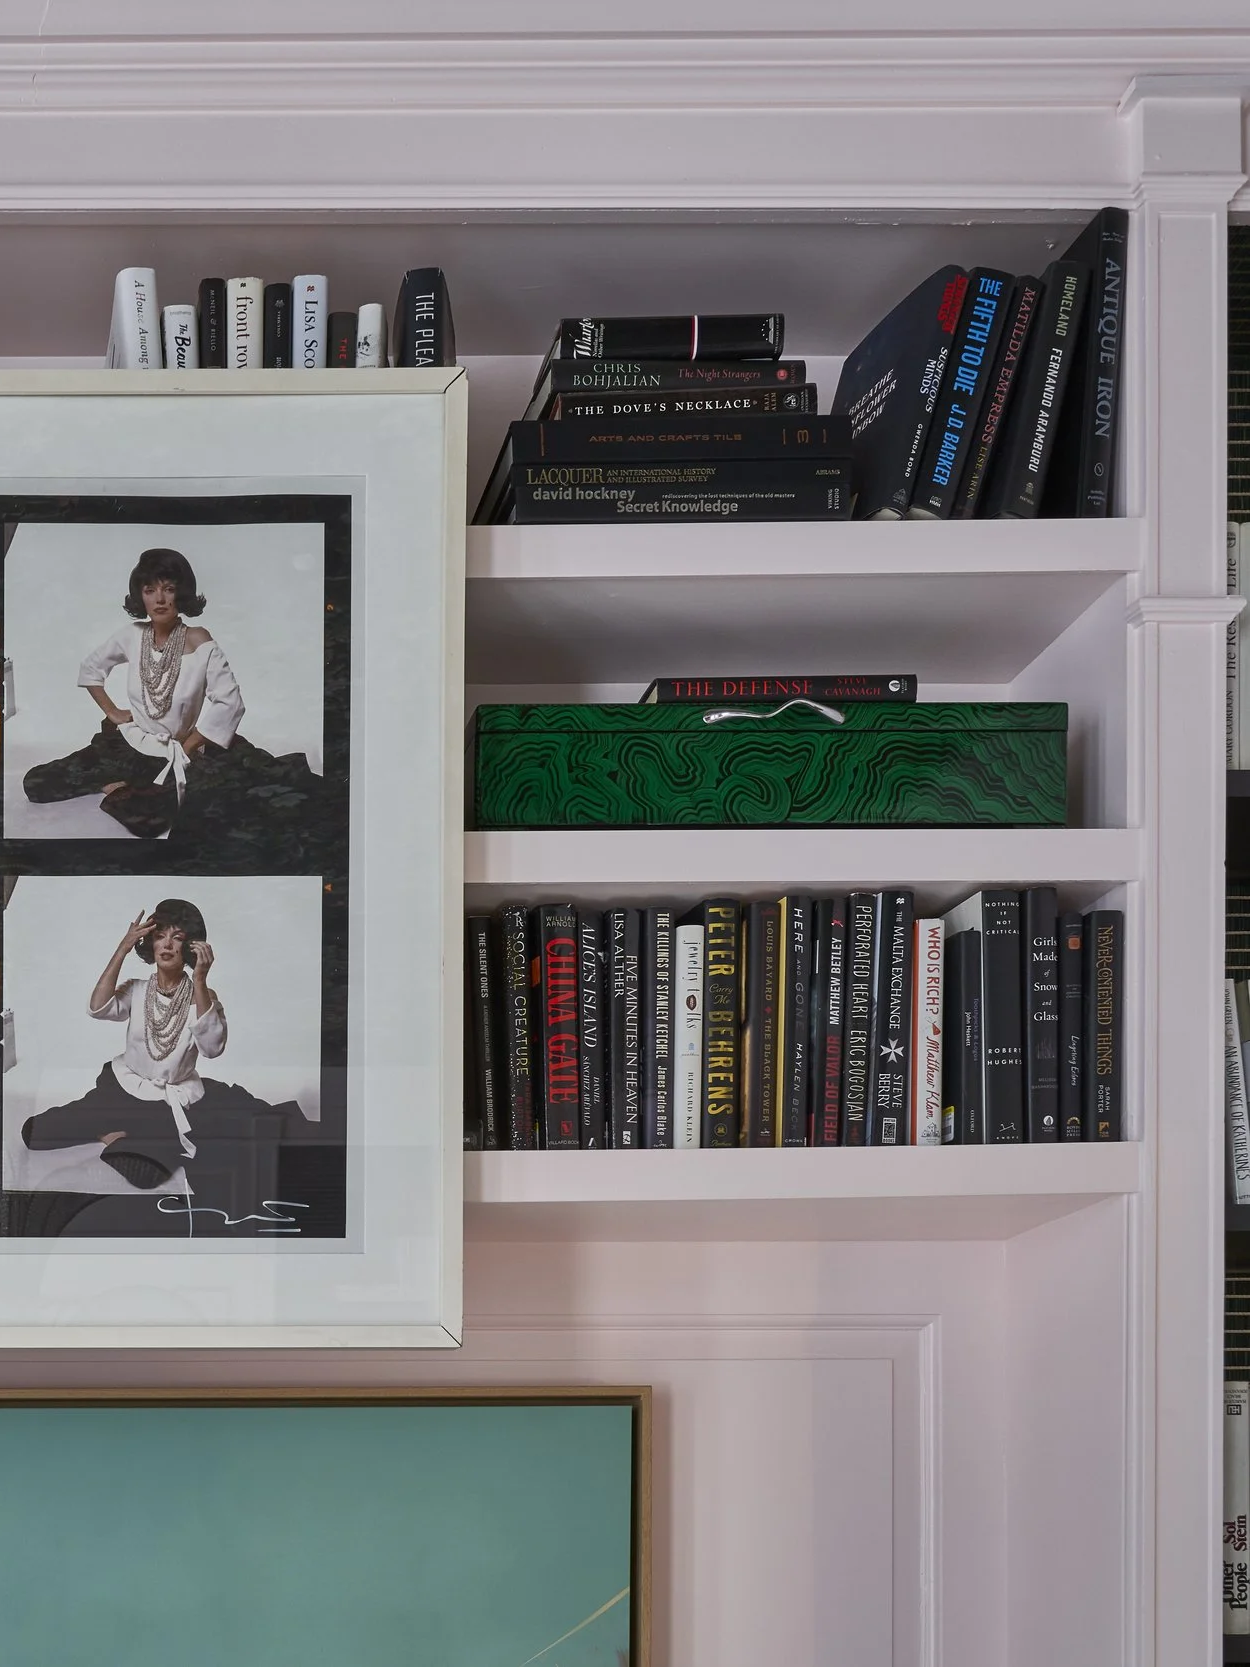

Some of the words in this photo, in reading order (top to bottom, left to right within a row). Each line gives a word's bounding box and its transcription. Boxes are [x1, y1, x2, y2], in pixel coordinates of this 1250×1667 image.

[304, 300, 318, 331] LISA
[416, 293, 434, 321] THE
[1055, 276, 1077, 336] HOMELAND
[1100, 258, 1122, 364] ANTIQUE
[416, 328, 434, 366] PLEA
[593, 363, 640, 373] CHRIS
[573, 375, 660, 386] BOHJALIAN
[925, 347, 948, 413] SUSPICIOUS
[1041, 348, 1063, 407] FERNANDO
[1094, 376, 1119, 439] IRON
[1028, 410, 1049, 472] ARAMBURU
[527, 469, 604, 485] LACQUER
[533, 487, 572, 499] david
[576, 488, 635, 502] hockney
[617, 501, 659, 513] Secret
[662, 501, 738, 515] Knowledge
[671, 680, 714, 696] THE
[722, 679, 813, 696] DEFENSE
[614, 913, 624, 939] LISA
[708, 908, 734, 976] PETER
[794, 908, 803, 953] HERE
[853, 906, 872, 977] PERFORATED
[1034, 937, 1056, 946] Girls
[582, 922, 596, 982] ALICE'S
[614, 945, 624, 997] ALTHER
[627, 955, 637, 982] FIVE
[1033, 953, 1057, 961] Made
[546, 938, 578, 1026] CHINA
[1034, 982, 1057, 991] Snow
[1095, 926, 1113, 1025] NEVER-CONTENTED
[583, 989, 597, 1048] ISLAND
[627, 987, 637, 1047] MINUTES
[795, 982, 804, 1033] GONE
[852, 984, 867, 1019] HEART
[1033, 1012, 1058, 1021] Glass
[627, 1052, 636, 1066] IN
[708, 1010, 734, 1115] BEHRENS
[850, 1030, 866, 1056] ERIC
[1095, 1029, 1114, 1075] THINGS
[548, 1033, 579, 1103] GATE
[794, 1043, 802, 1091] HAYLEN
[627, 1071, 637, 1123] HEAVEN
[847, 1061, 865, 1121] BOGOSIAN
[878, 1073, 890, 1108] BERRY
[892, 1074, 902, 1108] STEVE
